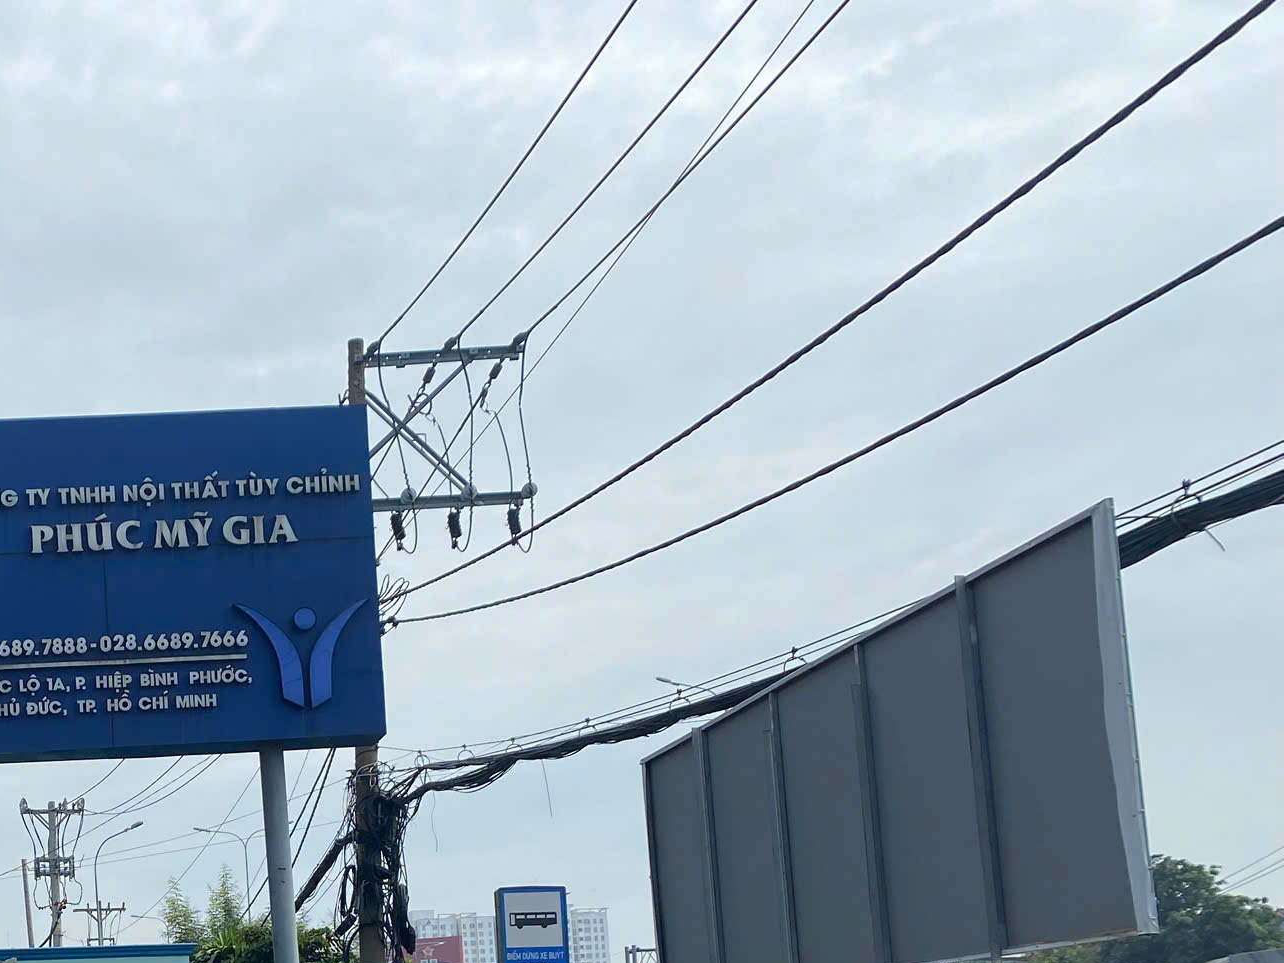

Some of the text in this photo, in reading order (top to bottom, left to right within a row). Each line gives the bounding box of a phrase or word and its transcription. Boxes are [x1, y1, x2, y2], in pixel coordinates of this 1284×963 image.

[25, 488, 51, 506] TY
[58, 485, 116, 505] TNHH
[123, 477, 165, 507] NỘI
[171, 471, 230, 500] THẤT
[235, 471, 279, 497] TÙY
[286, 467, 360, 494] CHỈNH
[30, 511, 299, 554] PHÚC MỸ GIA
[19, 674, 41, 696] LỘ
[46, 677, 70, 693] 1A,
[75, 676, 86, 690] P.
[95, 671, 133, 692] HIỆP
[140, 669, 179, 687] BÌNH
[189, 665, 253, 685] PHƯỚC,
[26, 696, 67, 717] ĐỨC,
[77, 700, 97, 713] TP.
[107, 689, 132, 712] HỒ
[138, 690, 169, 710] CHÍ
[176, 694, 217, 709] MINH
